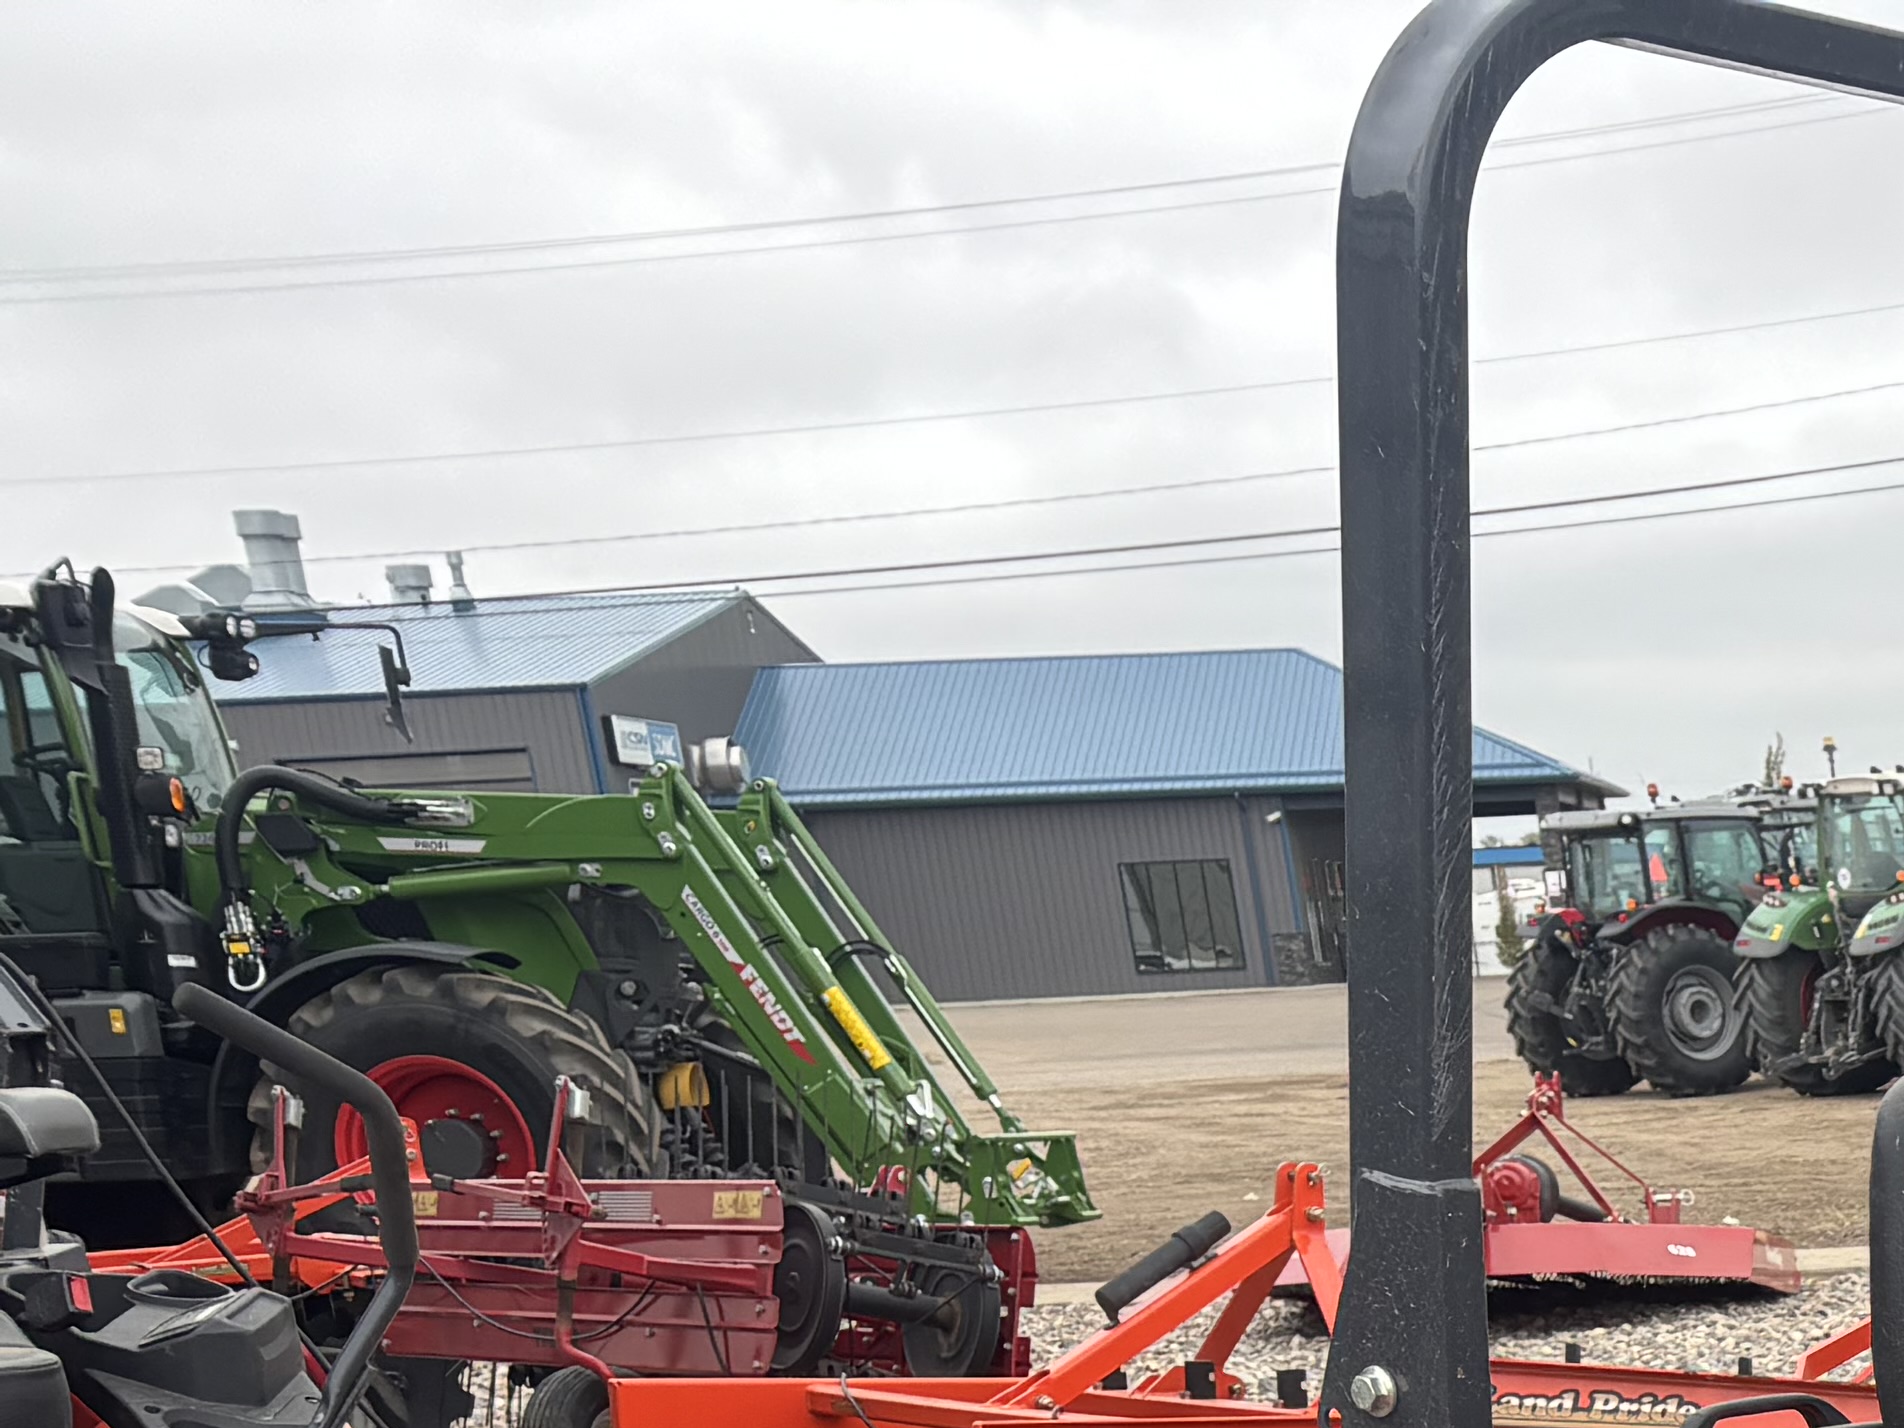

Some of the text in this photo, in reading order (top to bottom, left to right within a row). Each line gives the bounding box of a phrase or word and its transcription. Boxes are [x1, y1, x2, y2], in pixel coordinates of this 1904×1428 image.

[741, 962, 806, 1044] FENDT
[1492, 1390, 1698, 1423] and Pride
